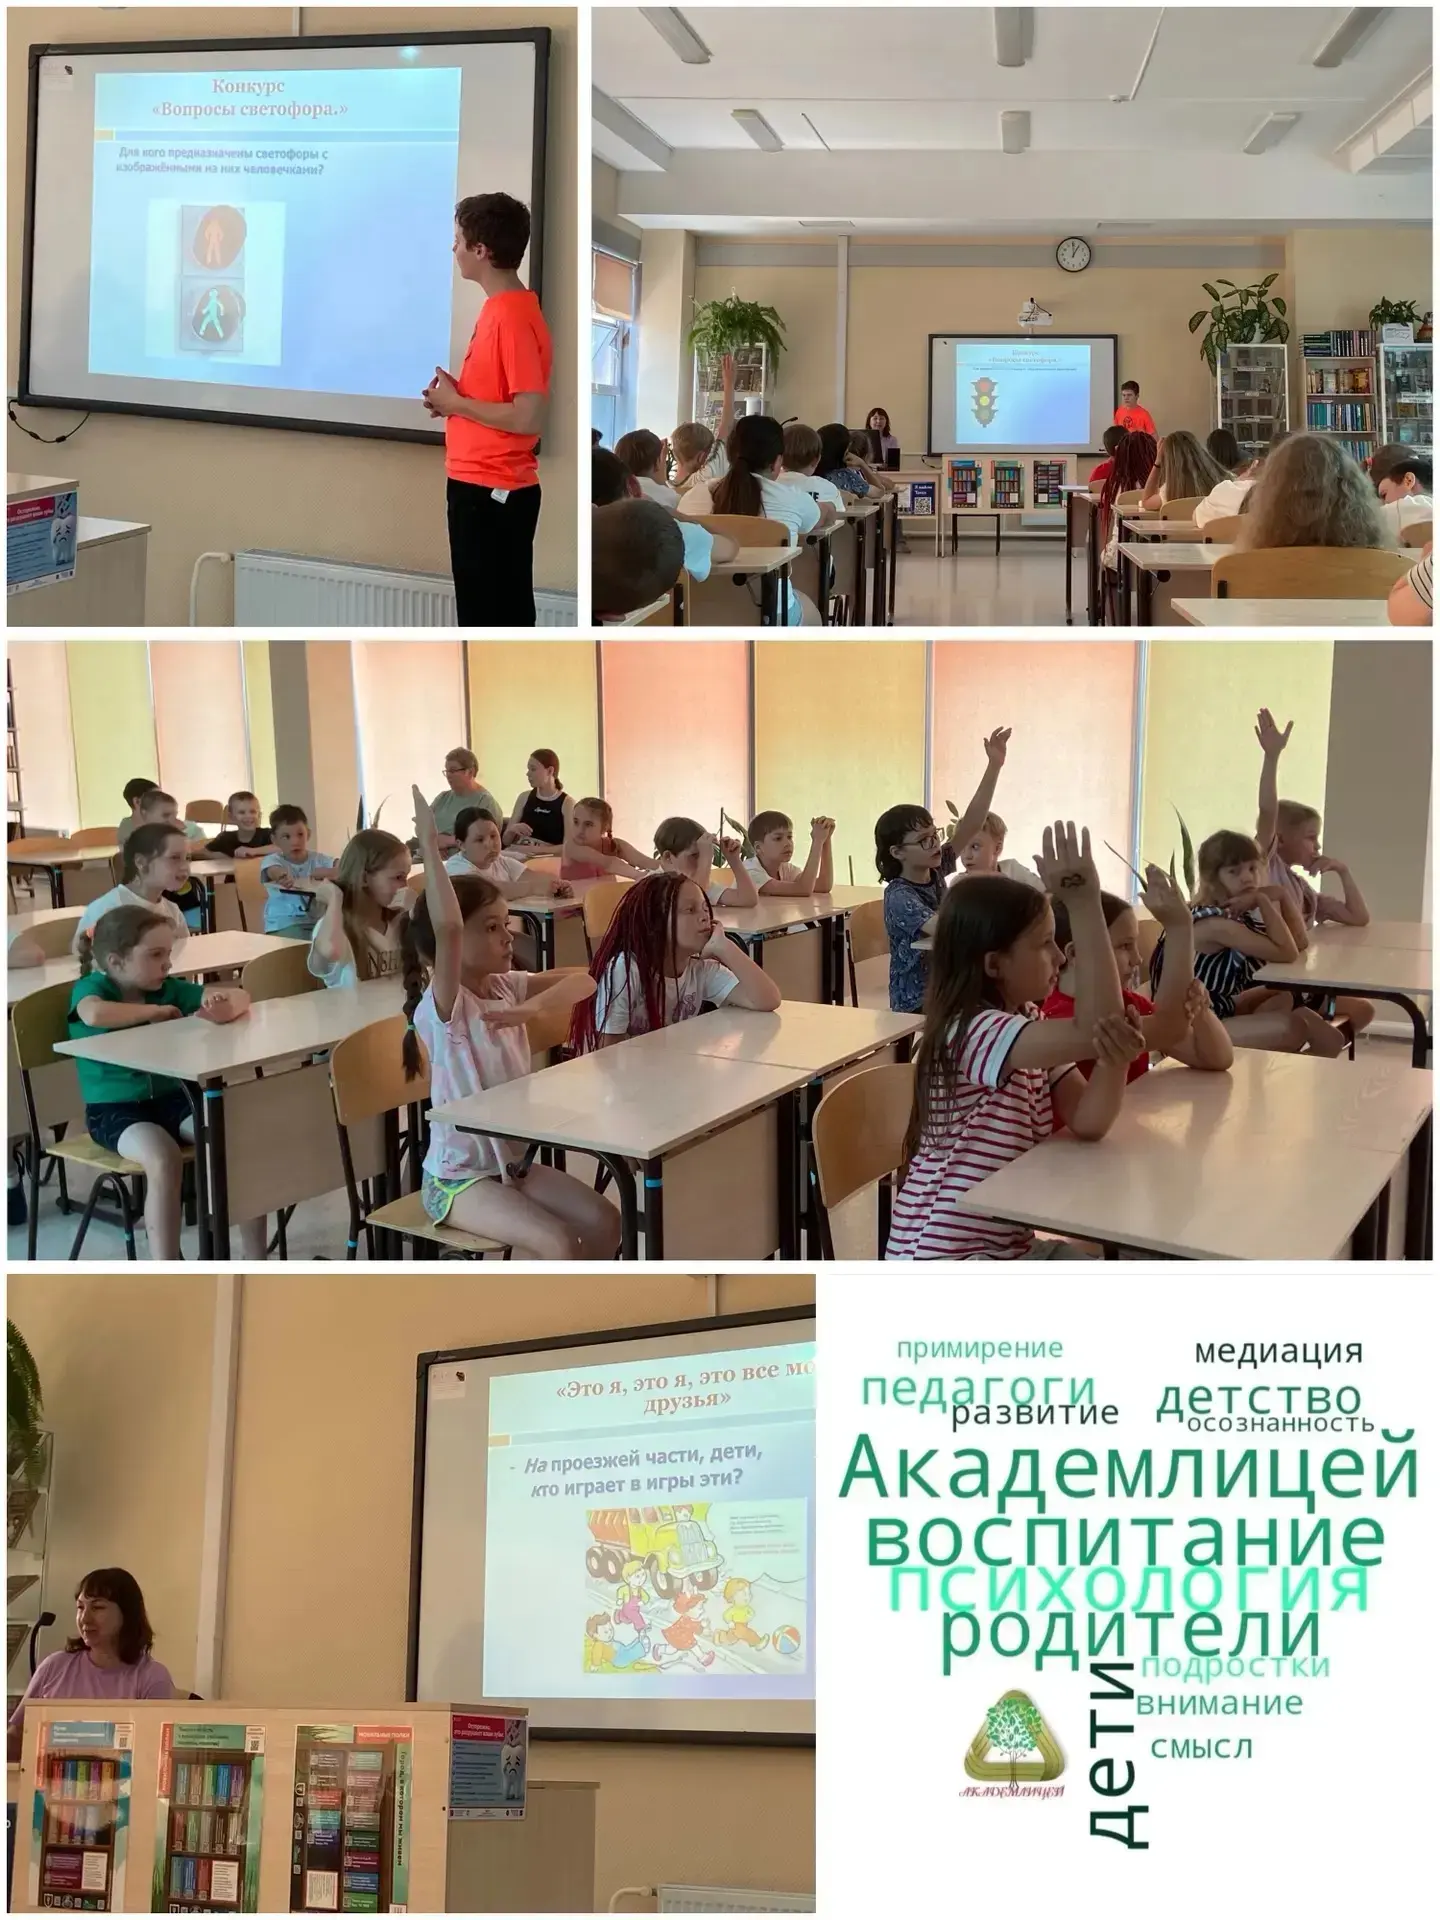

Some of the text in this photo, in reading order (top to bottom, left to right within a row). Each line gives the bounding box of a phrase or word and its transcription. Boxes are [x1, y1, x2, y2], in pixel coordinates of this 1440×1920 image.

[212, 79, 285, 96] Конкурс
[153, 101, 348, 119] «Вопросы светофора.»
[119, 147, 329, 161] Для кого предназначены светофоры с
[205, 165, 218, 173] на
[221, 165, 241, 174] них
[244, 164, 324, 176] человечками?
[898, 1341, 1063, 1364] примирение
[1196, 1343, 1363, 1369] медиация
[557, 1380, 604, 1398] «Это
[609, 1381, 628, 1396] я,
[633, 1376, 668, 1392] это
[674, 1373, 693, 1390] я,
[700, 1368, 736, 1385] это
[742, 1363, 779, 1380] все
[644, 1392, 731, 1416] друзья»
[863, 1376, 1094, 1414] педагоги
[1156, 1386, 1361, 1422] детство
[952, 1404, 1119, 1433] развитие
[1187, 1416, 1375, 1432] осознанность
[524, 1457, 548, 1474] На
[551, 1449, 640, 1475] проезжей
[646, 1447, 705, 1466] части,
[710, 1442, 763, 1464] дети,
[839, 1428, 1417, 1514] Академлицей
[531, 1468, 744, 1498] кто играет в игры эти?
[868, 1517, 1384, 1566] воспитание
[890, 1566, 1368, 1612] психология
[942, 1612, 1319, 1676] родители
[1142, 1657, 1330, 1685] подростки
[1137, 1695, 1303, 1715] внимание
[1089, 1662, 1149, 1849] дети
[1150, 1738, 1253, 1759] смысл
[958, 1785, 1065, 1800] АКАДЕМЛИЦЕЙ
